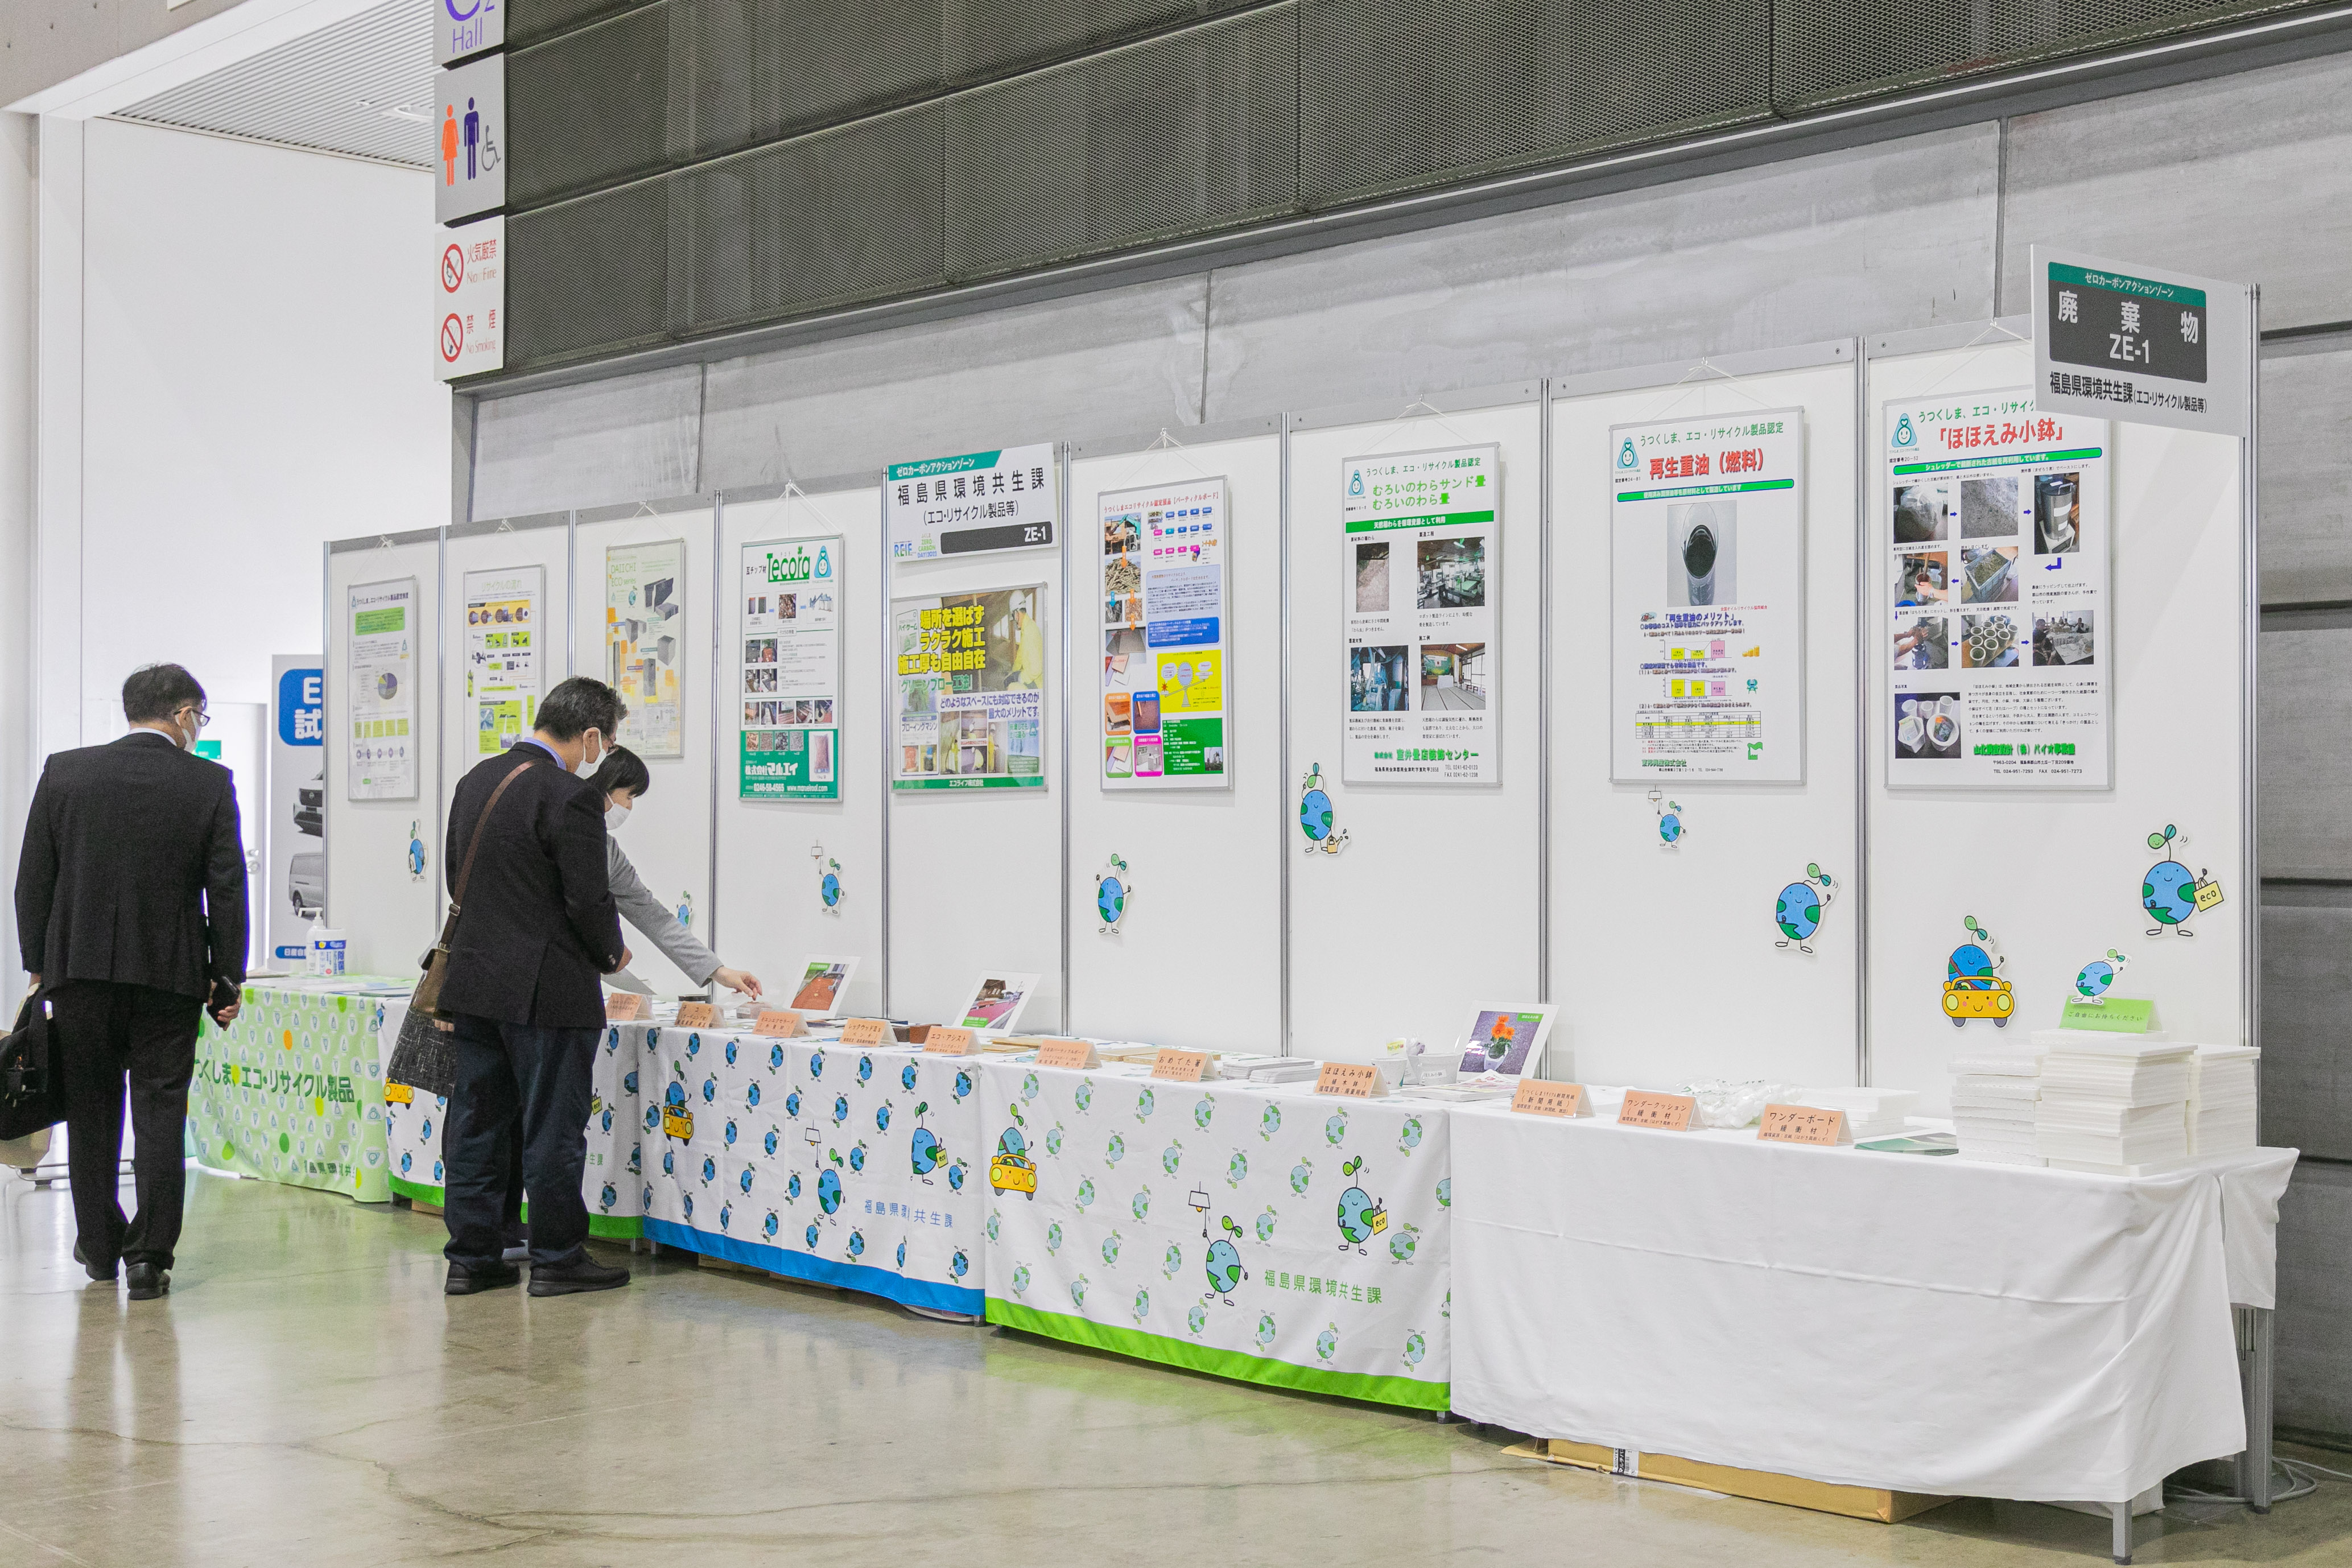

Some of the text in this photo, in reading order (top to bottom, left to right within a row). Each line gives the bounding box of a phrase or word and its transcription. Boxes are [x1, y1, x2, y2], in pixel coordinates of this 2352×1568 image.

[452, 16, 482, 53] Hall
[467, 238, 497, 265] 火気厳禁
[467, 268, 497, 284] No Fire
[2085, 272, 2174, 298] ゼロカーボンアクションゾーン
[466, 339, 496, 355] No Smoking
[2109, 333, 2149, 364] ZE-1
[1640, 421, 1784, 447] うつくしま、エコ・リサイクル製品認定
[1940, 417, 2064, 450] 「ほほえみ小鉢」
[897, 458, 975, 477] ゼロカーボンアクションゾーン
[1366, 457, 1481, 477] うつくしま、エコ・リサイクル製品認定
[1649, 448, 1764, 480] 再生重油（燃料）
[898, 468, 1044, 506] 福島県環境共生課
[1024, 526, 1046, 542] ZE-1
[894, 543, 912, 557] REIF
[612, 577, 623, 587] ECO
[920, 605, 985, 630] 場所を選ばず
[920, 626, 985, 651] ラクラク施工
[898, 649, 986, 676] 施工厚も自由自在
[940, 692, 1039, 708] どのようなスペースにも対応できるのが
[988, 705, 1039, 719] 最大のメリットです。
[2200, 890, 2217, 902] eco
[1325, 1067, 1373, 1079] ほほえみ小鉢
[1628, 1099, 1687, 1112] ワンダークッション
[1770, 1112, 1835, 1126] ワンダーボード
[1376, 1217, 1385, 1227] eco
[1264, 1269, 1383, 1304] 福島県環境共生課
